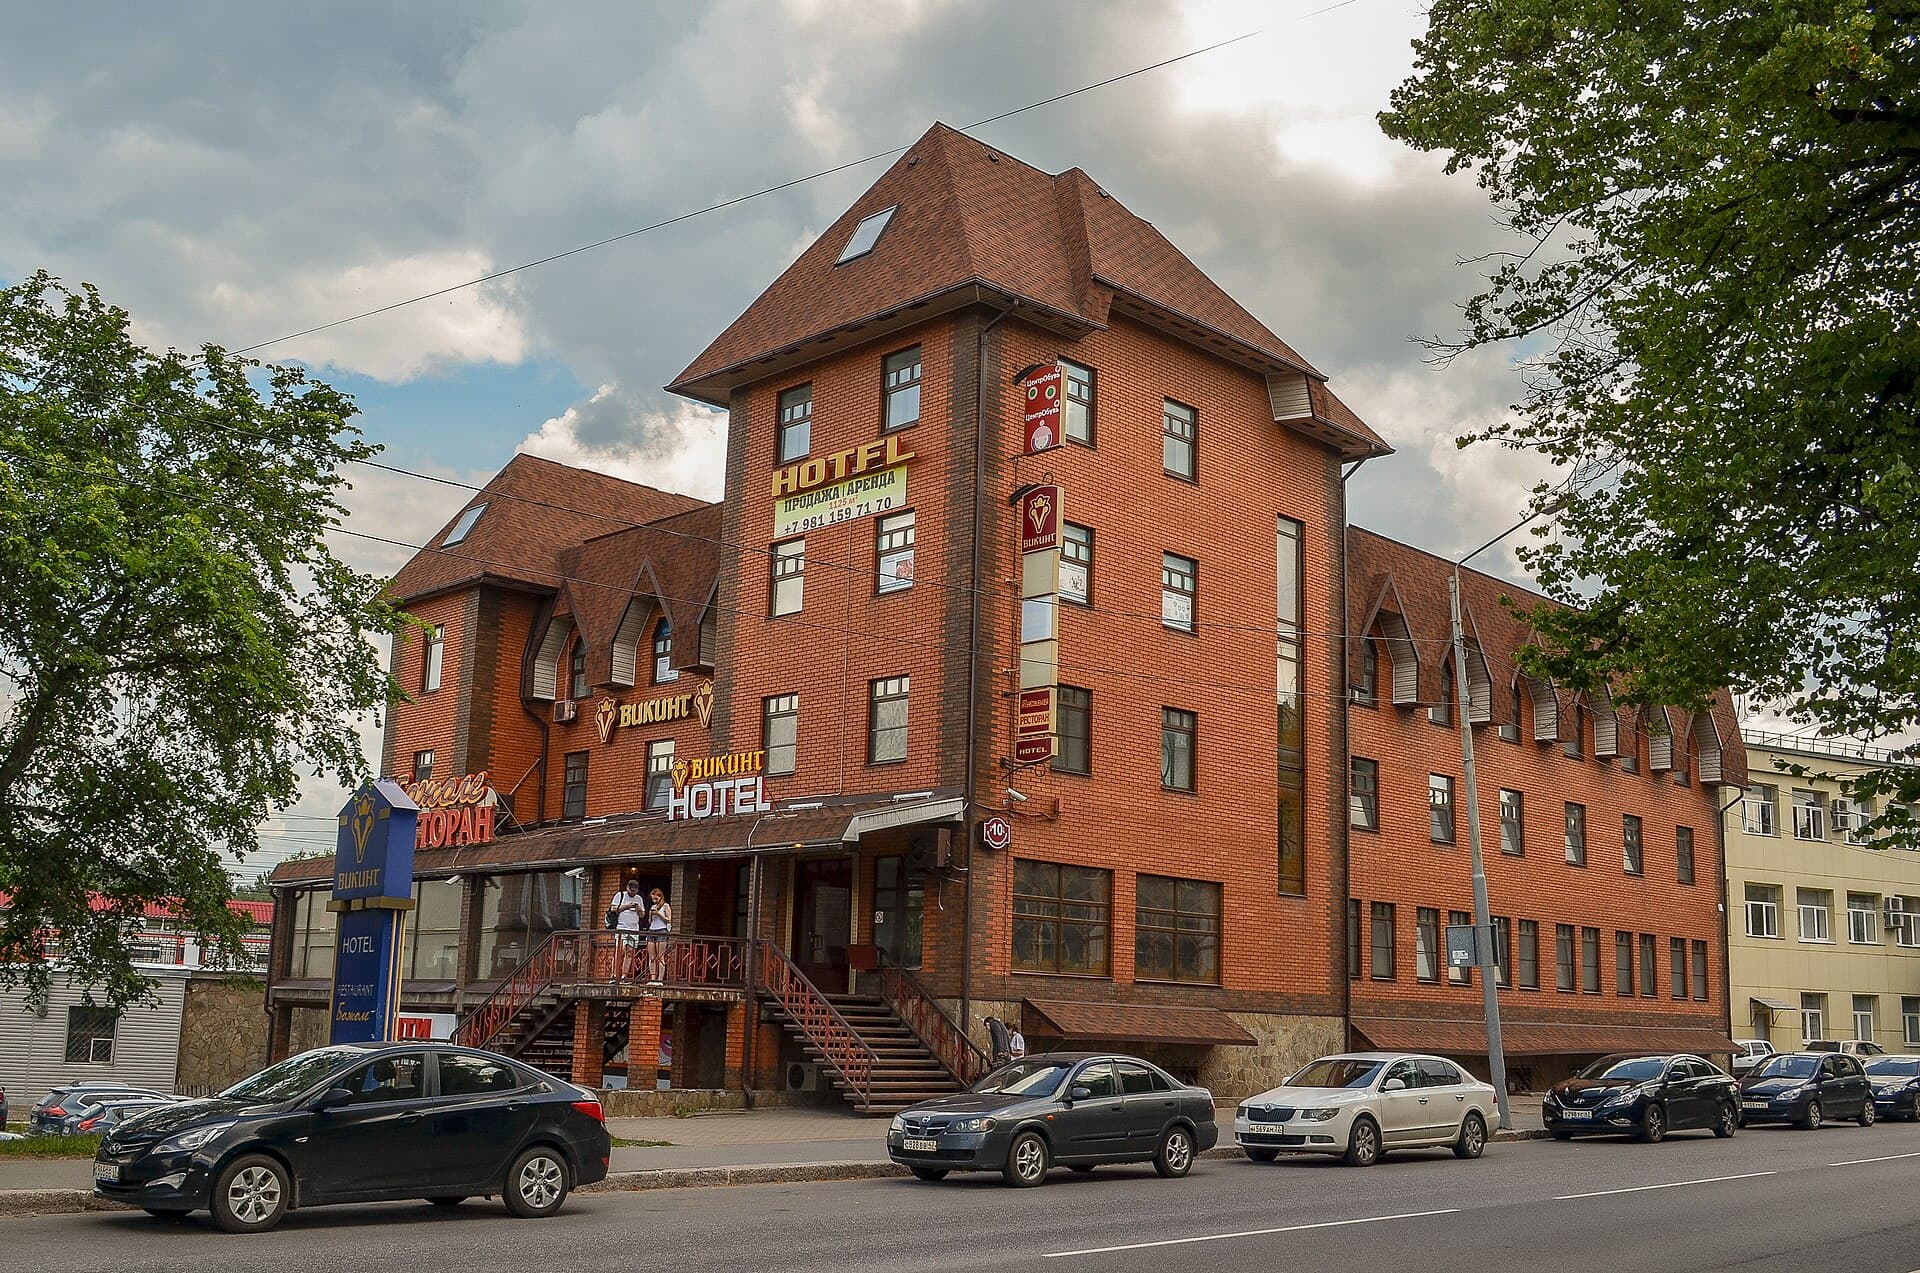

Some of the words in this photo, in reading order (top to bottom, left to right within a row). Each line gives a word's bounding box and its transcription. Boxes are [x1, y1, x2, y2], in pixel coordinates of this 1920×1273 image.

[772, 436, 915, 497] HOTEL
[784, 484, 840, 513] ПРОДАЖА
[847, 470, 896, 496] АРЕНДА
[803, 514, 825, 531] 981
[830, 507, 852, 523] 159
[856, 501, 872, 517] 71
[877, 496, 892, 511] 70
[1019, 746, 1048, 755] HOTEL
[668, 776, 772, 821] HOTEL
[416, 806, 495, 849] ТОРАН
[991, 823, 1003, 836] 10
[342, 936, 375, 954] HOTEL
